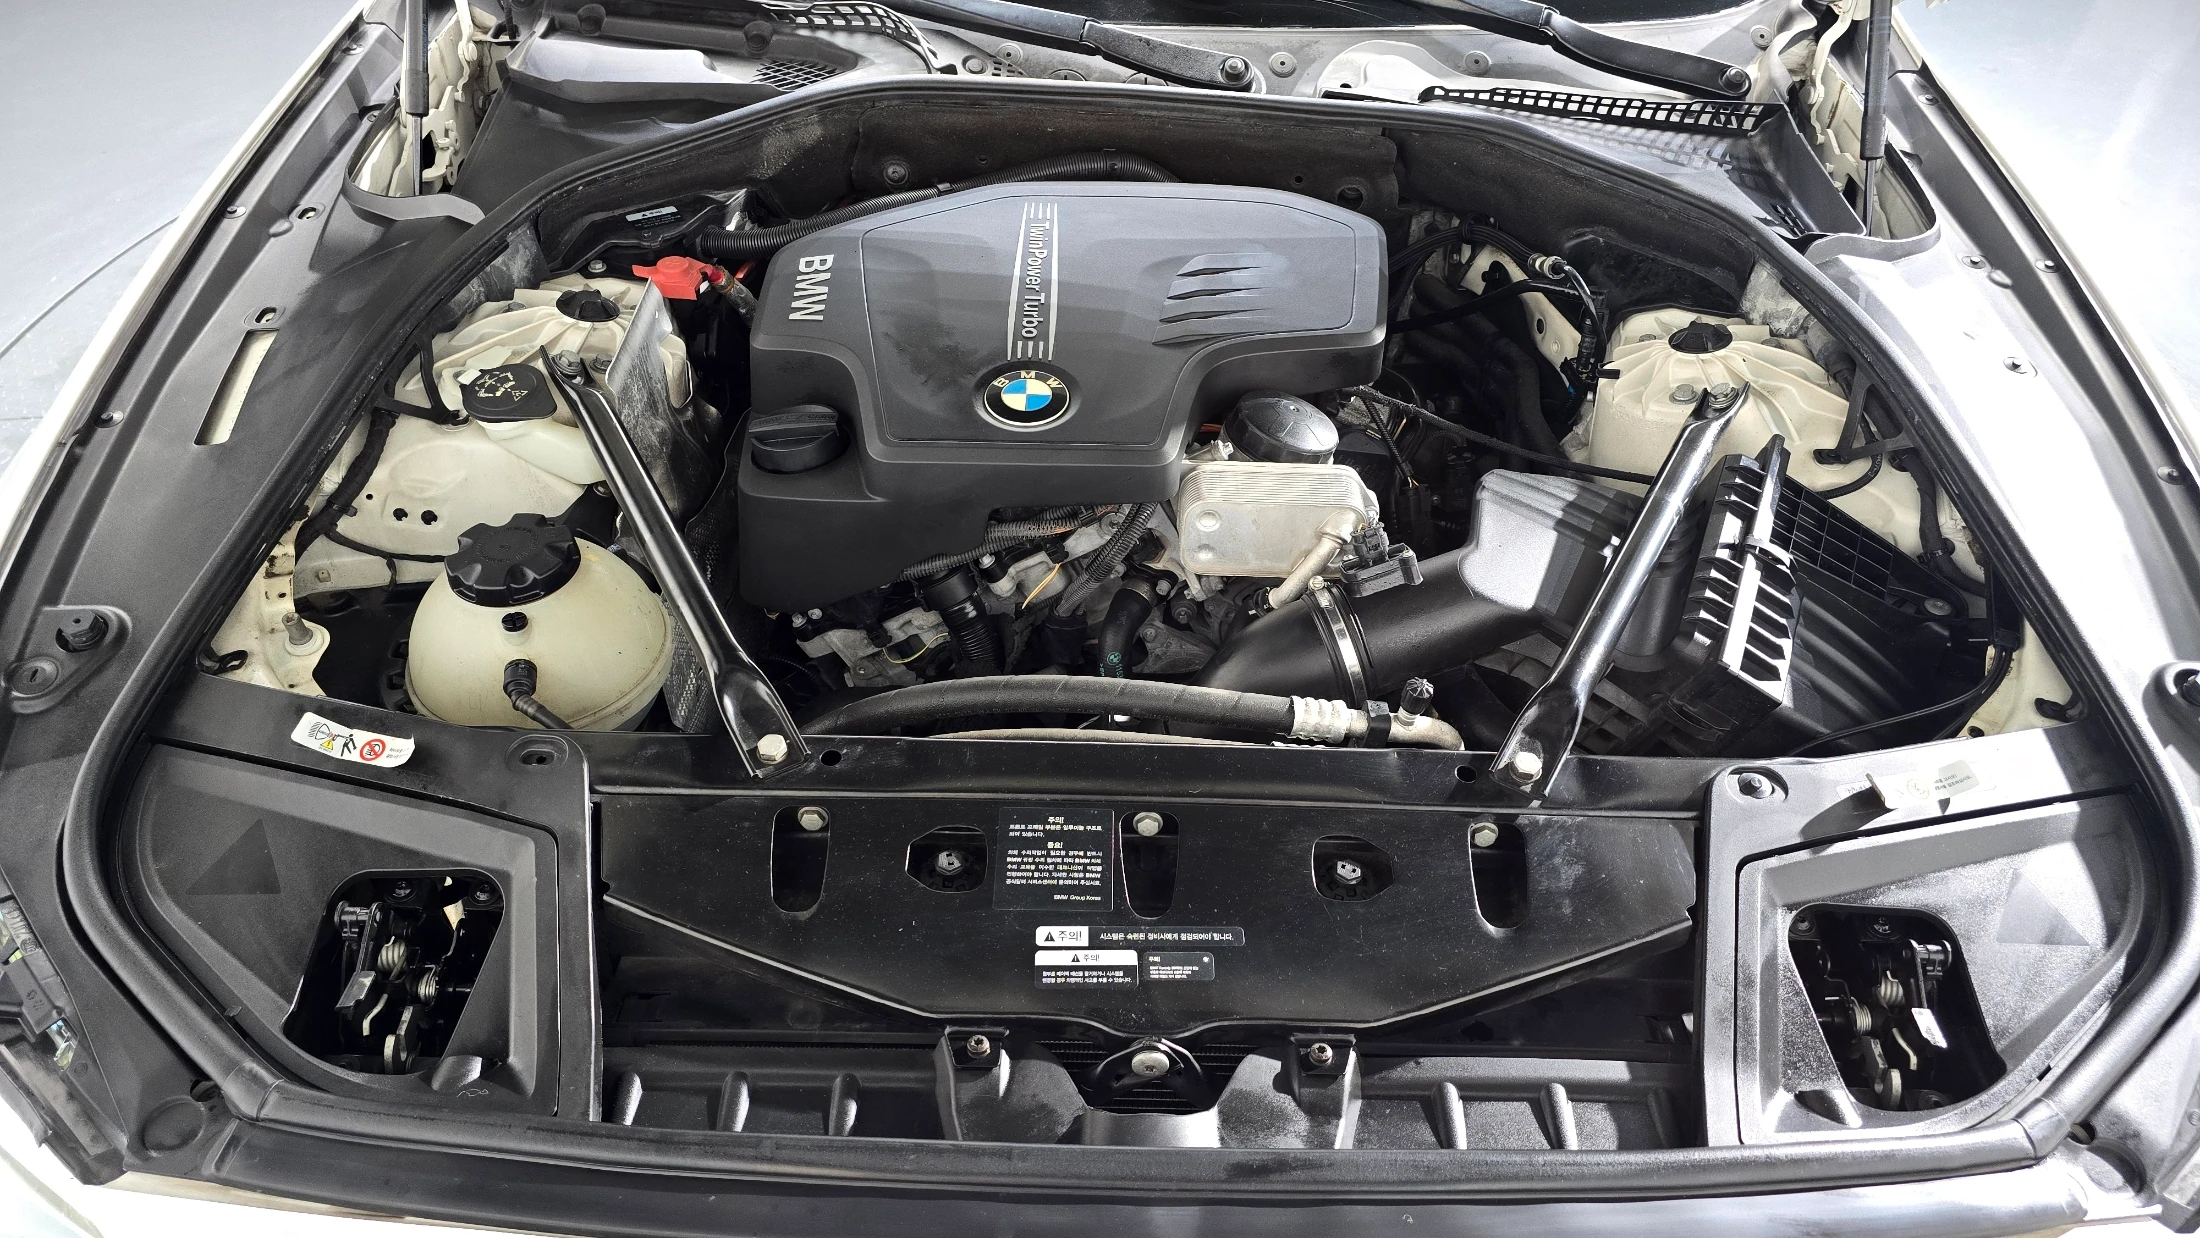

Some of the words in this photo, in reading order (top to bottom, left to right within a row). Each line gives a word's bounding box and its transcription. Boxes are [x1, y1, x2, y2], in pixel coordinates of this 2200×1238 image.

[1025, 221, 1050, 292] TwinPower
[789, 254, 834, 321] BMW
[1022, 292, 1046, 338] Turbo
[1047, 816, 1064, 824] 주의!
[1058, 930, 1082, 941] 주의!
[1100, 932, 1125, 940] 시스템은
[1126, 932, 1145, 940] 숙련된
[1147, 932, 1178, 941] 정비사에게
[1180, 932, 1211, 941] 점검되어야
[1213, 932, 1234, 940] 합니다.
[1083, 953, 1100, 962] 주의!
